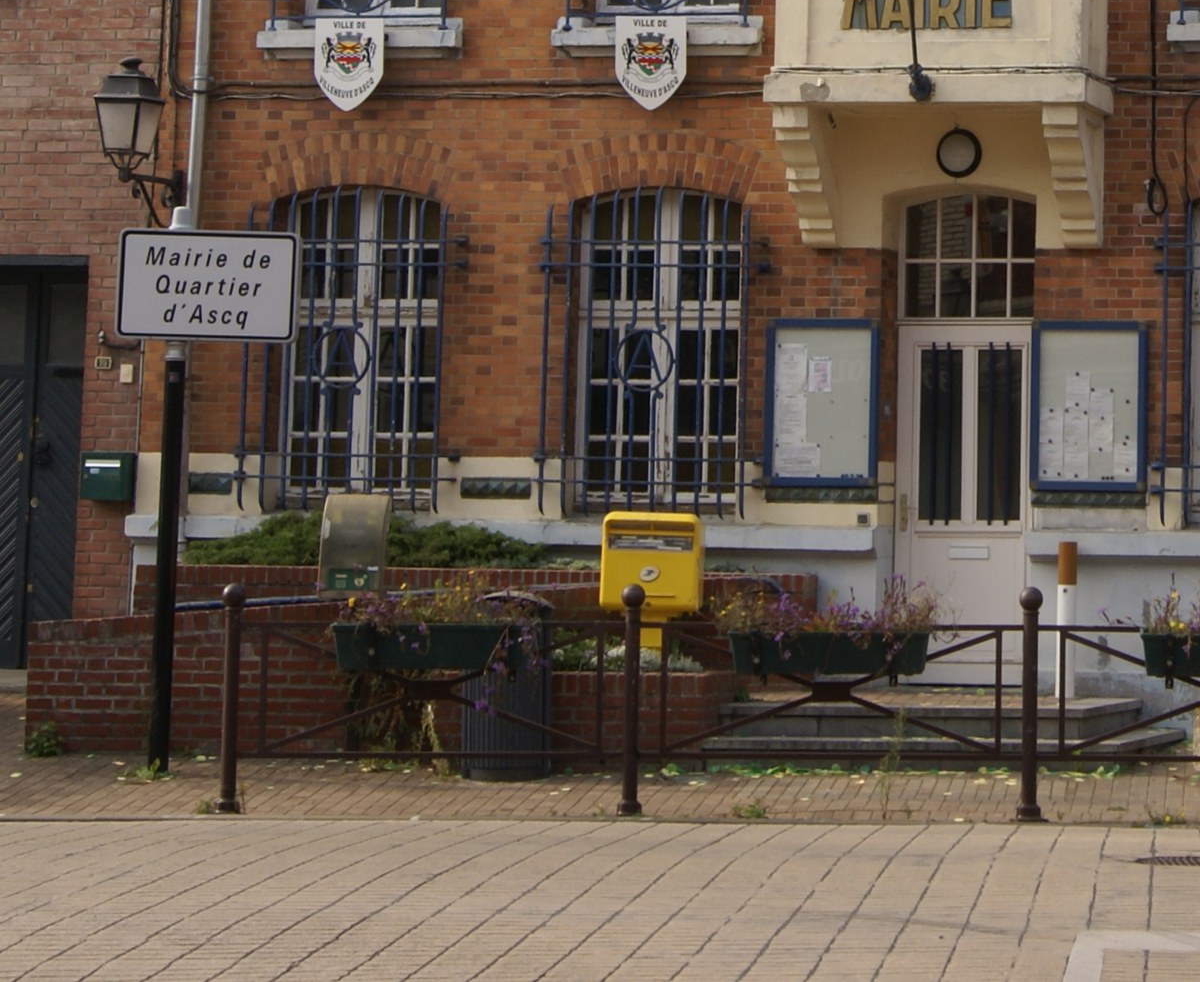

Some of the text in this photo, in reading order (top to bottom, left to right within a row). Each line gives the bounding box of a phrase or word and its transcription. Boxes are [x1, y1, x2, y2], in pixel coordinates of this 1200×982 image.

[333, 21, 366, 29] VILLE DE
[633, 19, 667, 27] VILLE DE
[319, 76, 353, 98] VILLENEUVE
[622, 74, 657, 98] VILLENEUVE
[145, 246, 271, 269] Mairie de
[155, 274, 262, 297] Quartier
[163, 303, 249, 330] d'Ascq
